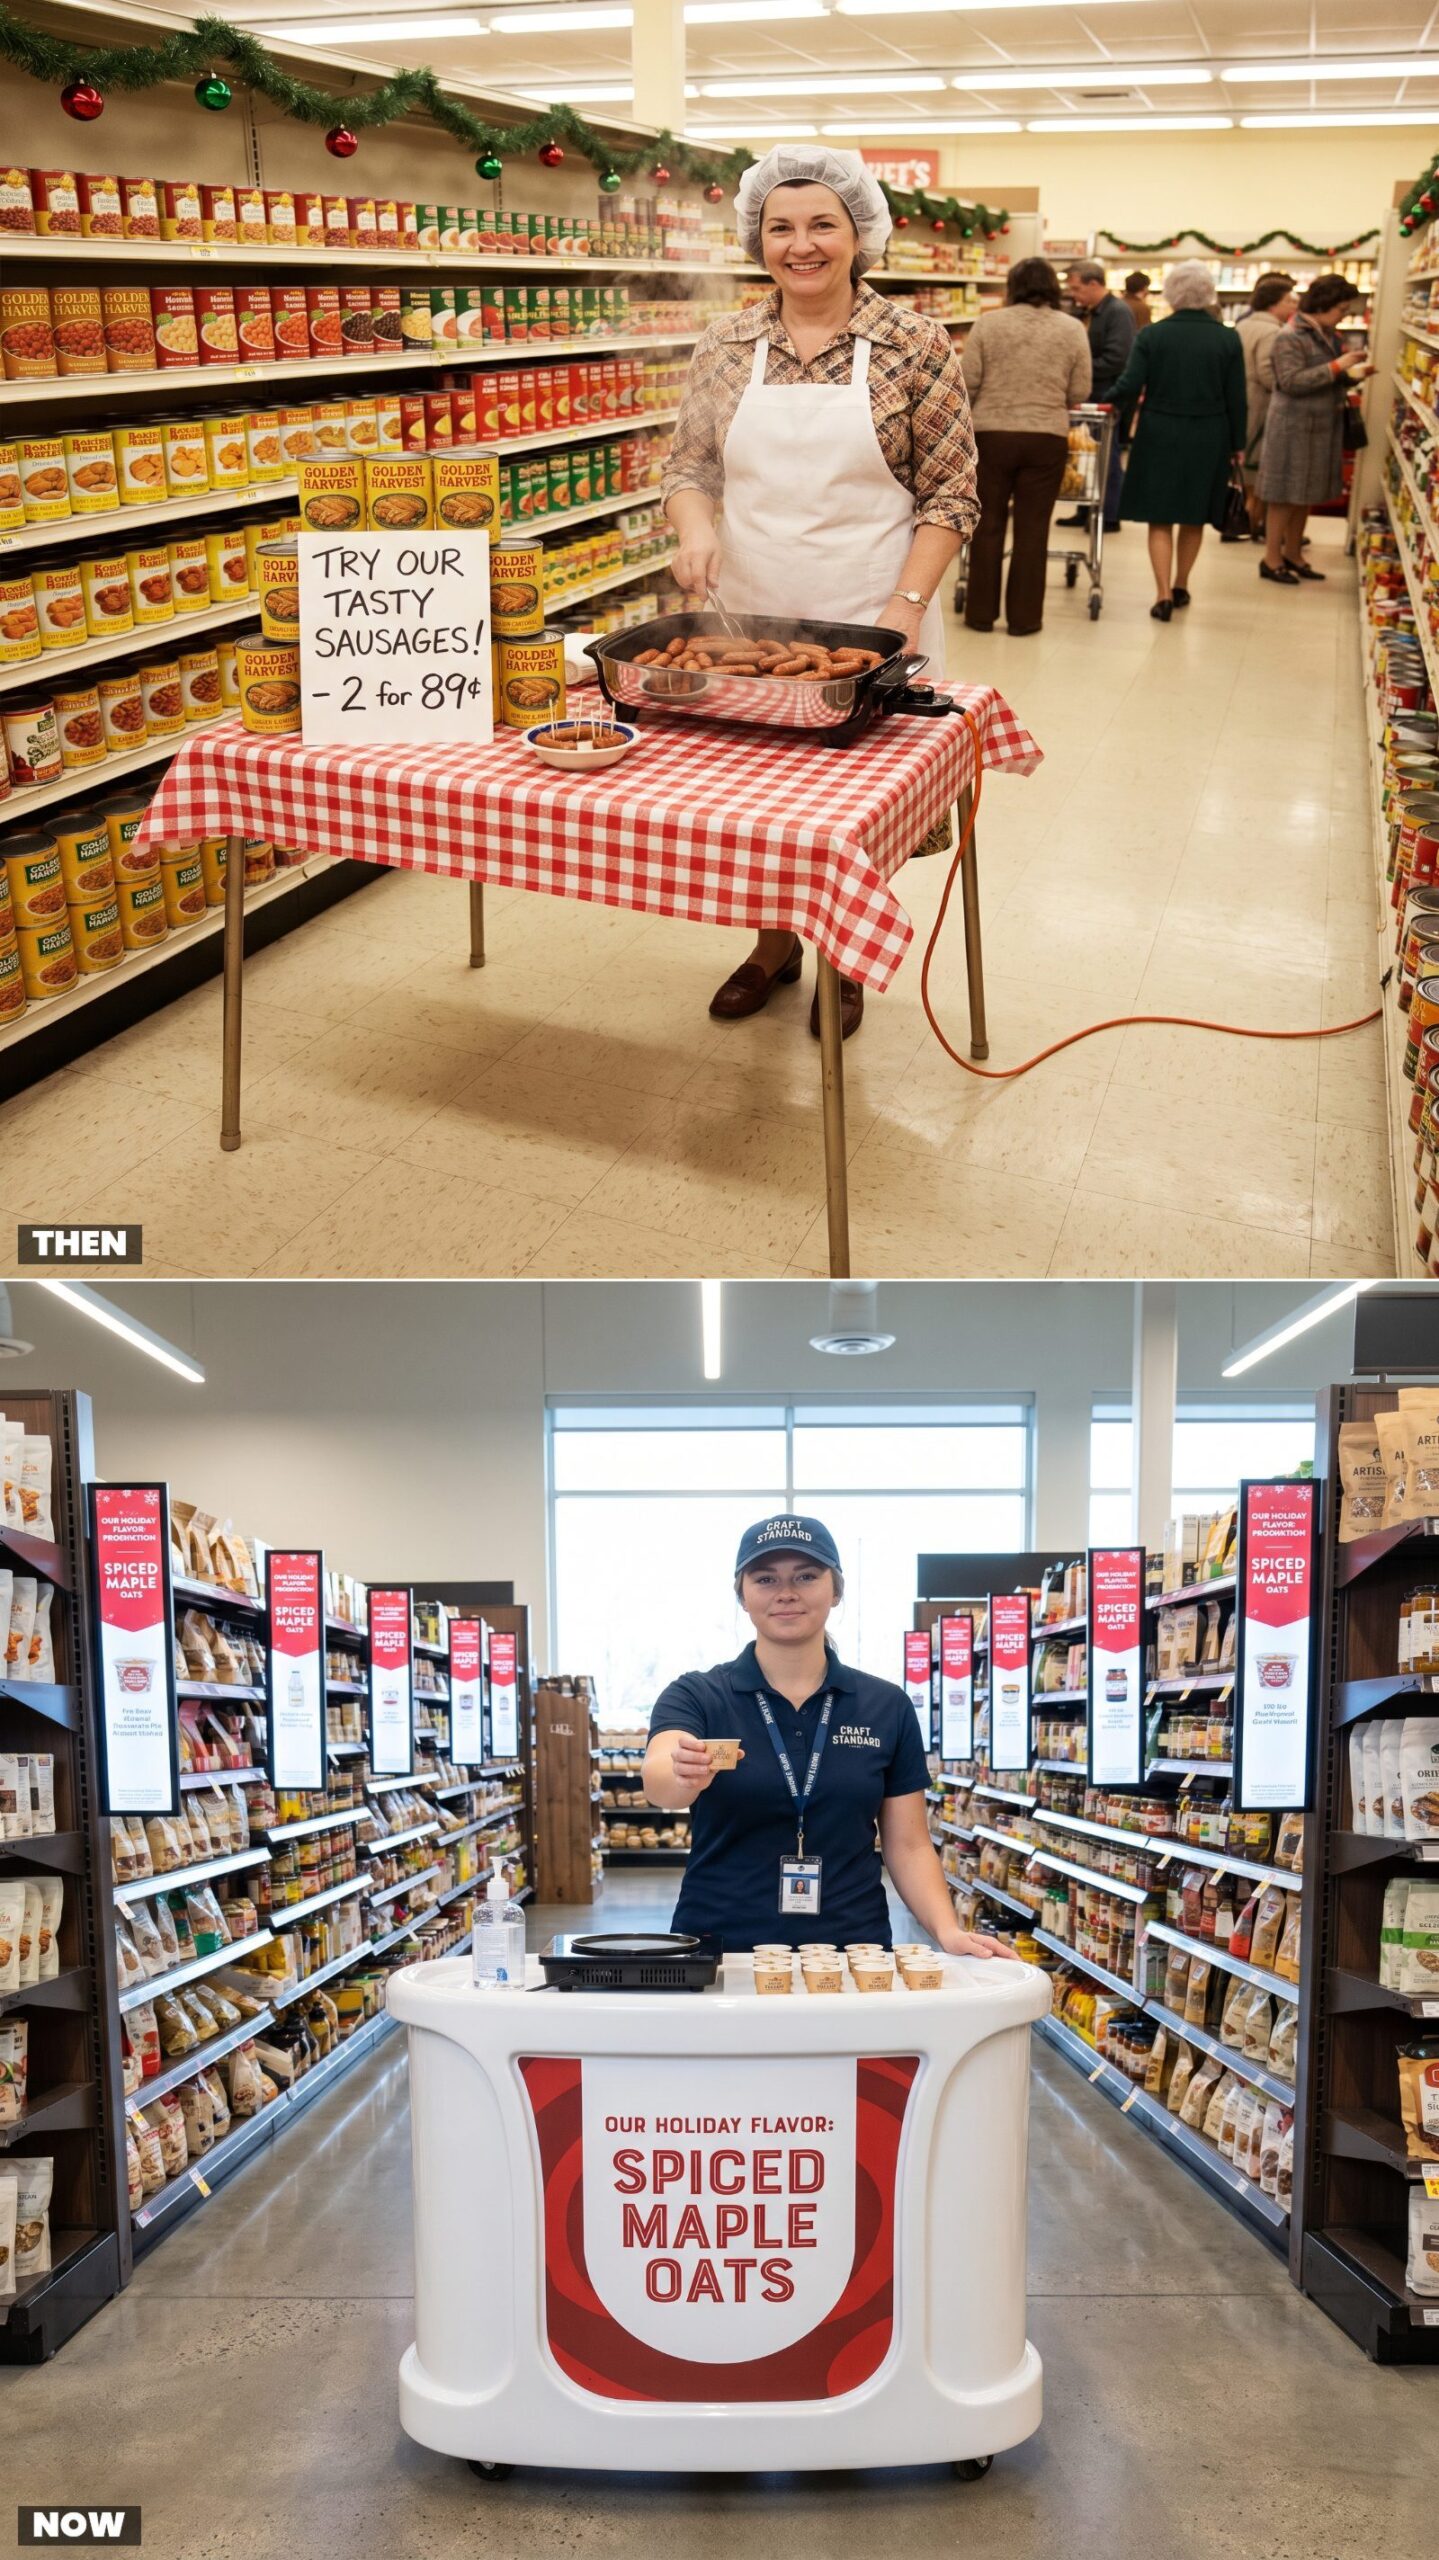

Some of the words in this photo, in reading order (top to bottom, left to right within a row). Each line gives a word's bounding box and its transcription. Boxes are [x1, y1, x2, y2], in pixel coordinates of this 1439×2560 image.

[3, 305, 50, 317] HARVES
[54, 304, 100, 315] HARVES
[104, 303, 151, 314] HARVES
[304, 465, 356, 478] GOLDEN
[372, 465, 423, 477] GOLDEN
[441, 464, 491, 476] GOLDEN
[303, 478, 359, 489] HARVEST
[371, 476, 426, 488] HARVEST
[439, 475, 494, 487] HARVEST
[263, 560, 298, 571] GOLD
[312, 546, 381, 580] TRY
[397, 548, 465, 577] OUR
[490, 565, 537, 578] ARVEST
[323, 587, 435, 619] TASTY
[314, 619, 485, 658] SAUSAGES!
[245, 652, 295, 666] GOLDEN
[507, 649, 556, 661] GOLDEN
[244, 662, 299, 677] HARVEST
[506, 659, 559, 671] HARVEST
[341, 675, 367, 712] 2
[376, 680, 412, 706] for
[421, 672, 482, 710] 89¢
[101, 1517, 120, 1525] OUR
[766, 1520, 803, 1531] CRAFT
[756, 1528, 812, 1544] STANDARD
[104, 1563, 158, 1575] SPICED
[1251, 1558, 1306, 1570] SPICED
[106, 1577, 157, 1589] MAPLE
[1252, 1571, 1303, 1584] MAPLE
[275, 1606, 315, 1616] SPICED
[1097, 1604, 1137, 1613] SPICED
[276, 1617, 314, 1626] MAPLE
[1098, 1614, 1135, 1623] MAPLE
[375, 1639, 405, 1647] MAPLE
[995, 1633, 1025, 1641] SPICED
[995, 1641, 1024, 1649] MAPLE
[840, 1725, 871, 1736] CRAFT
[832, 1734, 881, 1748] STANDARD
[605, 2116, 646, 2132] OUR
[656, 2117, 742, 2133] HOLIDAY
[751, 2116, 834, 2133] FLAVOR:
[613, 2149, 825, 2195] SPICED
[623, 2203, 817, 2249] MAPLE
[645, 2258, 795, 2303] OATS
